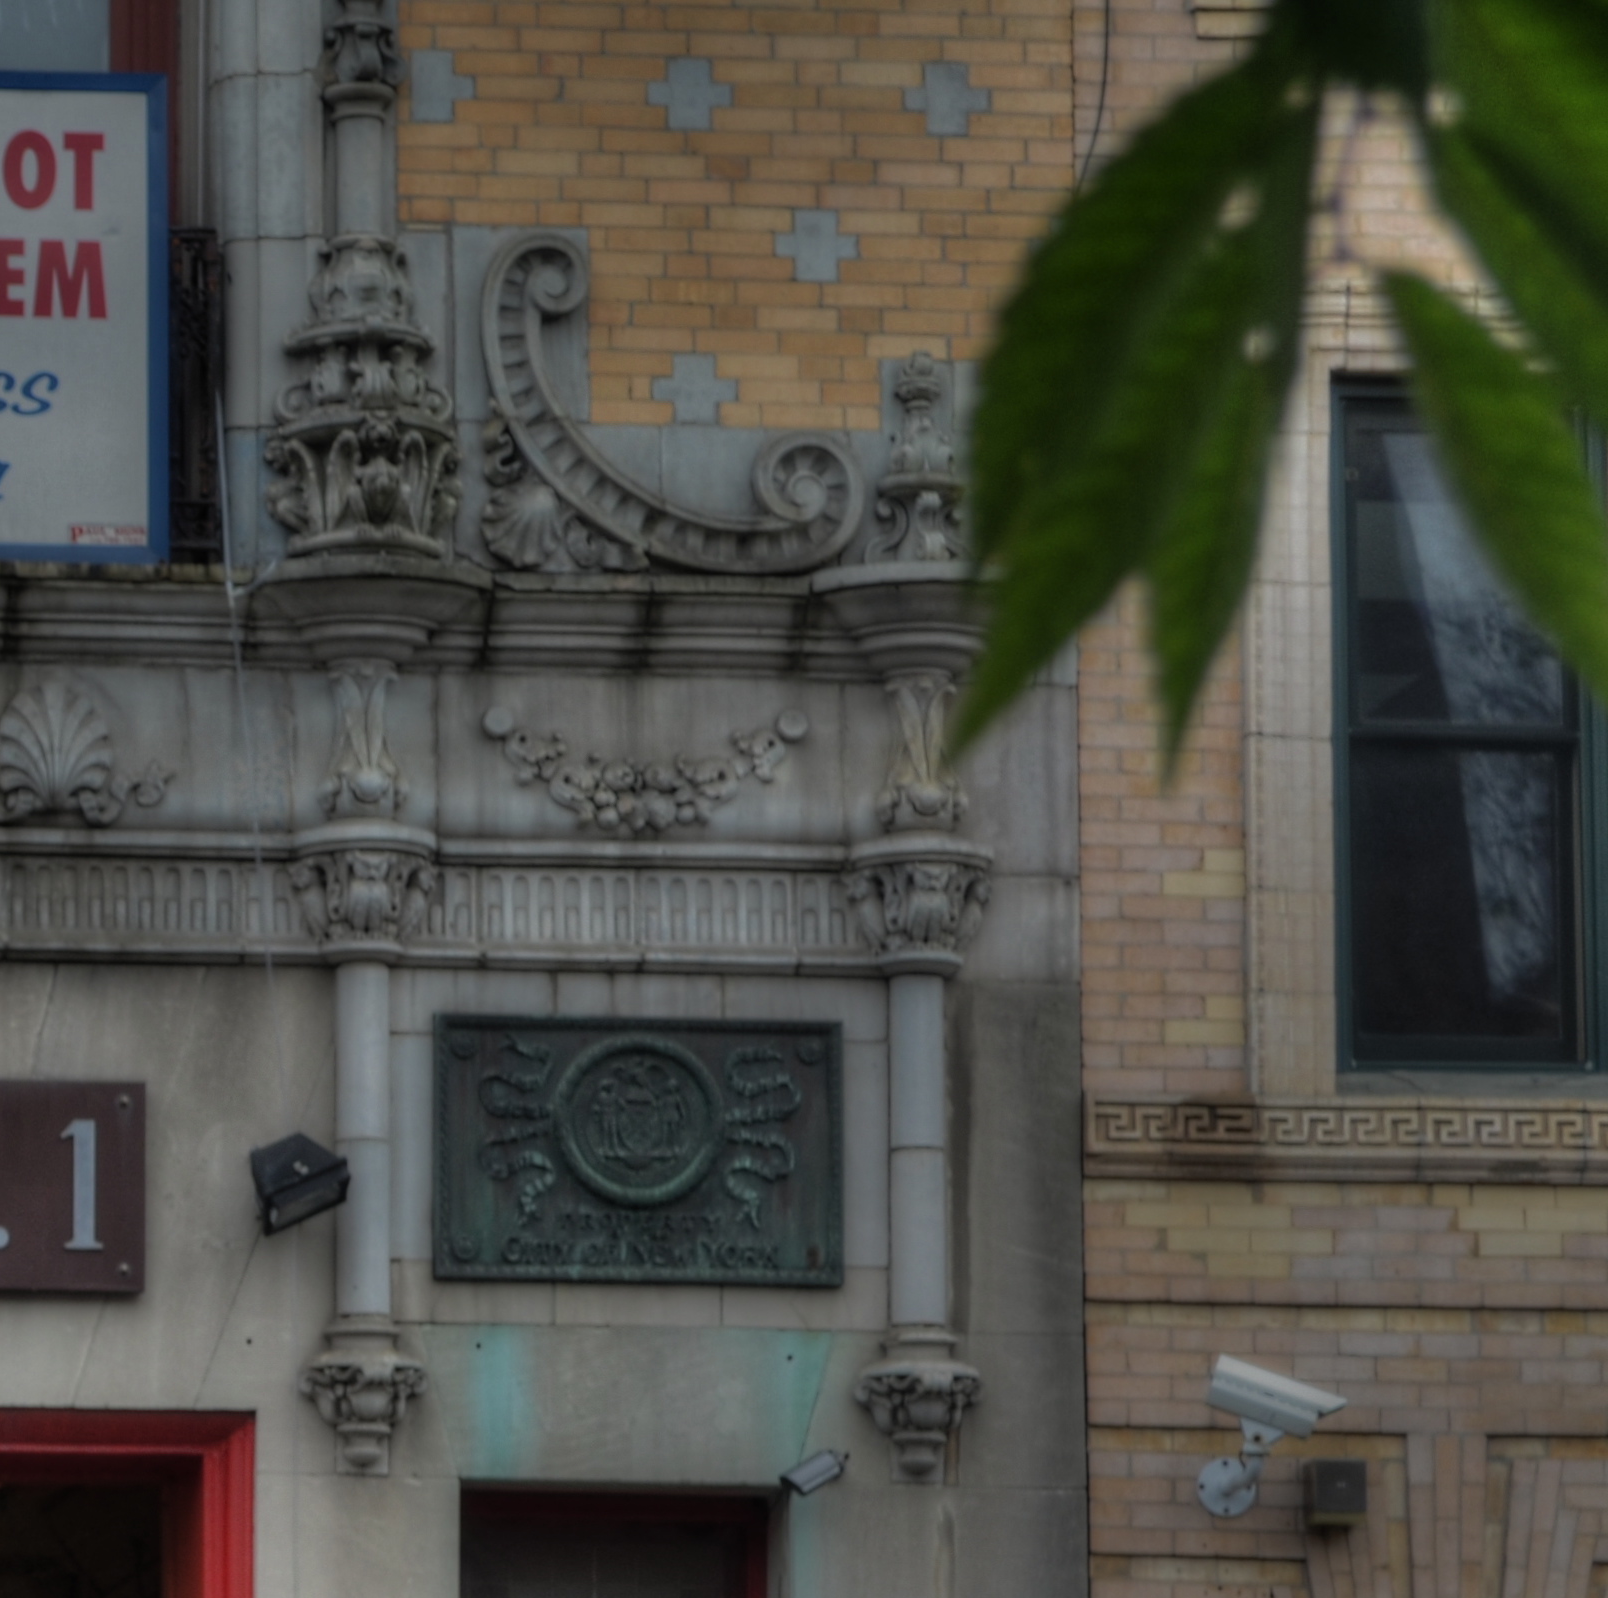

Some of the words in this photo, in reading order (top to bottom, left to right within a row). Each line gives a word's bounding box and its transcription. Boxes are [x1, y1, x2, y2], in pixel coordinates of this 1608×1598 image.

[57, 1117, 106, 1252] 1
[501, 1236, 577, 1267] CITY
[696, 1237, 782, 1270] YORK
